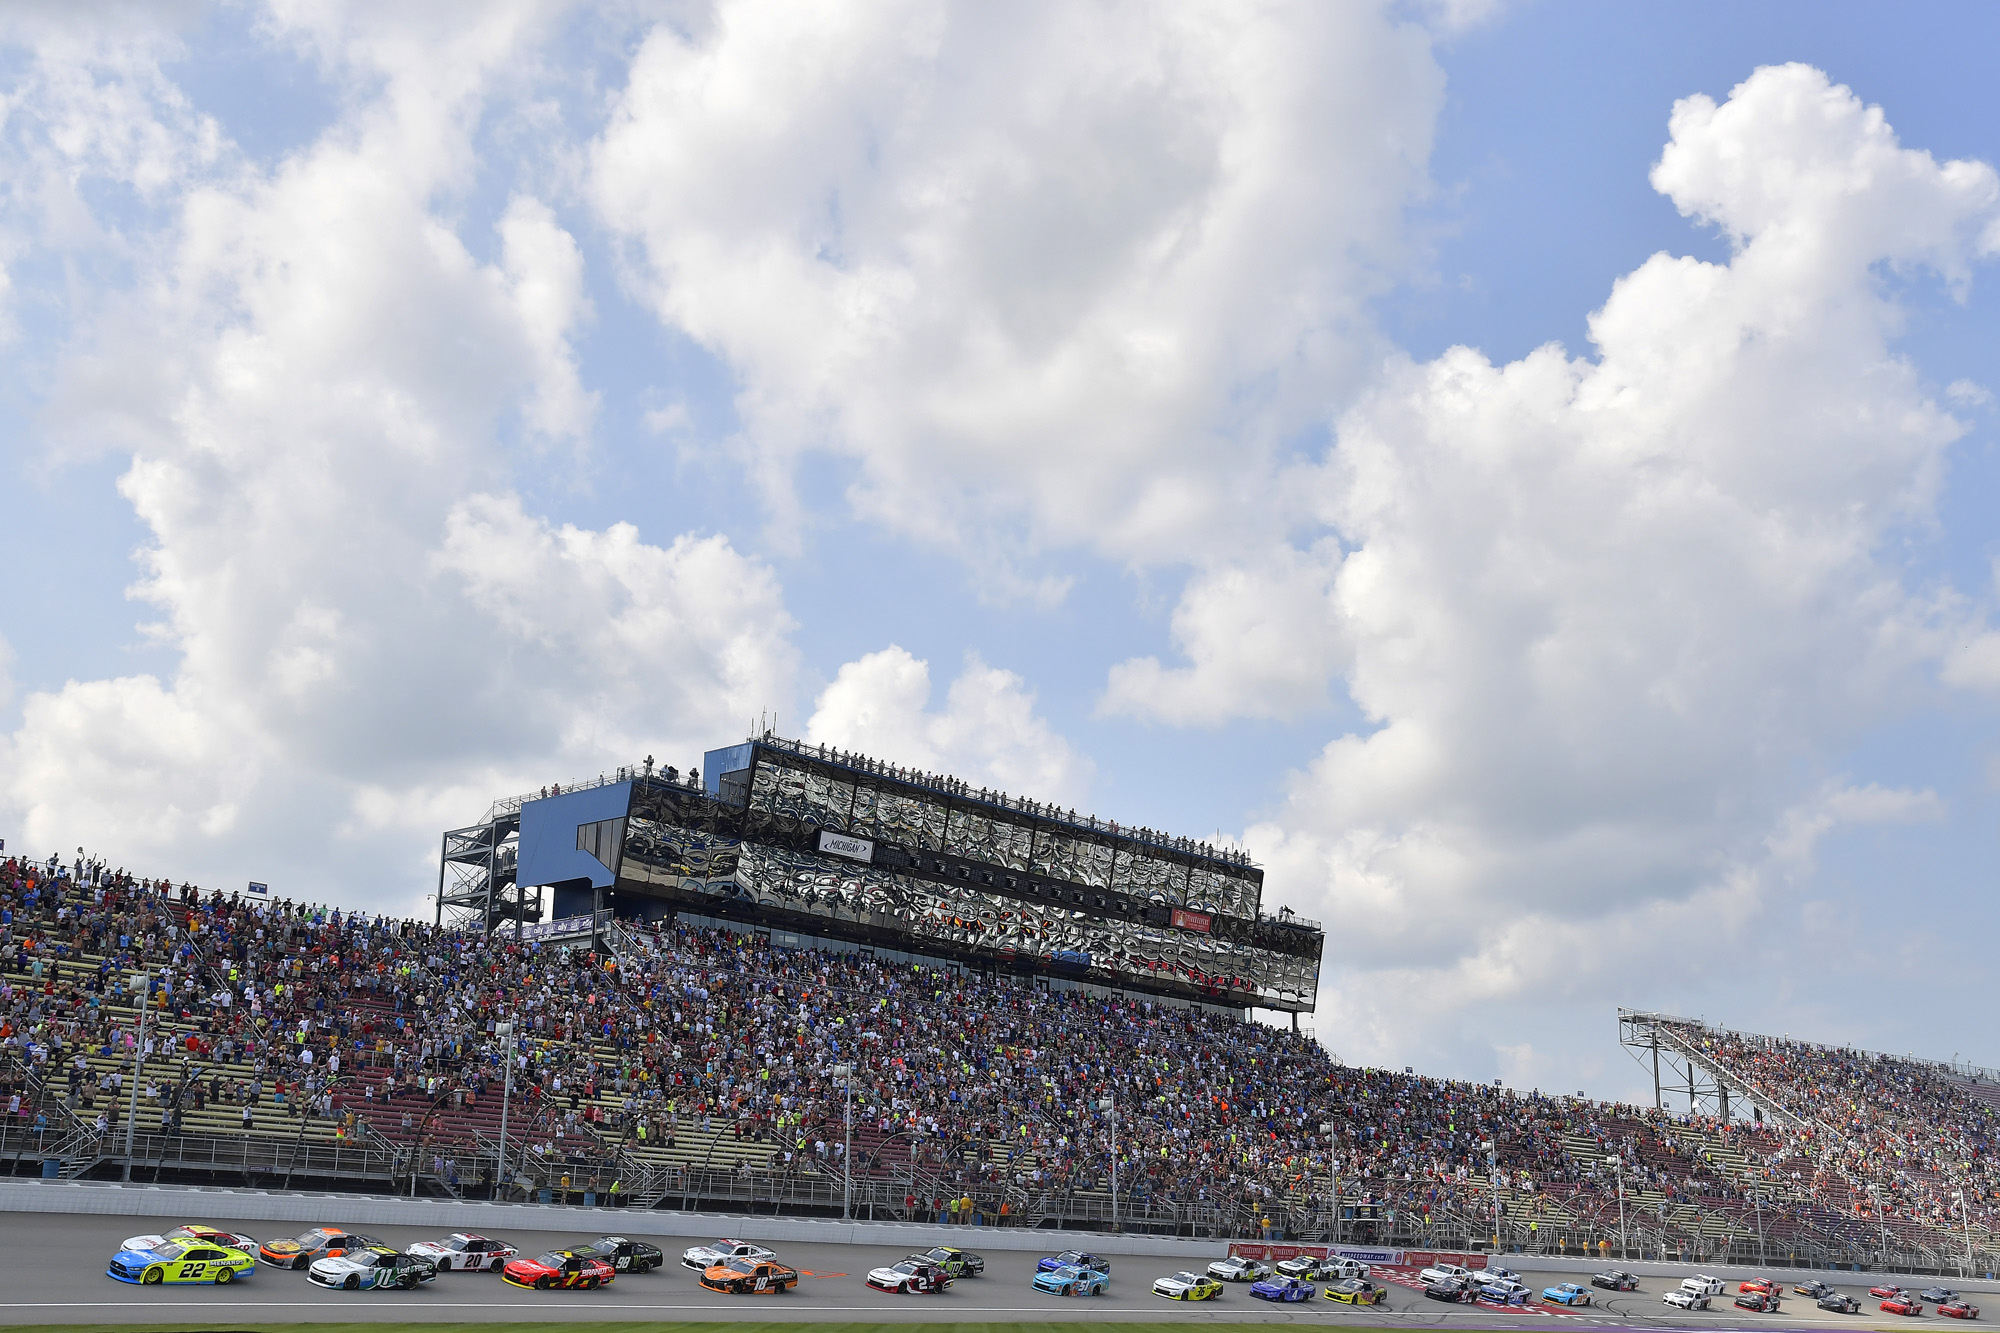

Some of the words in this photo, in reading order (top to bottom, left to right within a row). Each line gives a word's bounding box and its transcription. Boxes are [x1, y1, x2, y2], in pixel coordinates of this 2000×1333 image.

[829, 839, 861, 854] MICHIGAN
[533, 926, 544, 935] ally
[557, 922, 568, 932] ally
[464, 1253, 483, 1269] 20
[615, 1256, 631, 1269] 98
[1340, 1252, 1385, 1261] MISPEEDWAY.com
[178, 1262, 206, 1279] 22
[377, 1268, 393, 1286] 11
[396, 1266, 410, 1275] Leaf
[581, 1268, 608, 1278] BRANDT
[566, 1271, 580, 1286] 7
[753, 1276, 769, 1291] 18
[918, 1277, 928, 1290] 2
[1078, 1280, 1091, 1292] 51
[1291, 1289, 1299, 1300] 4
